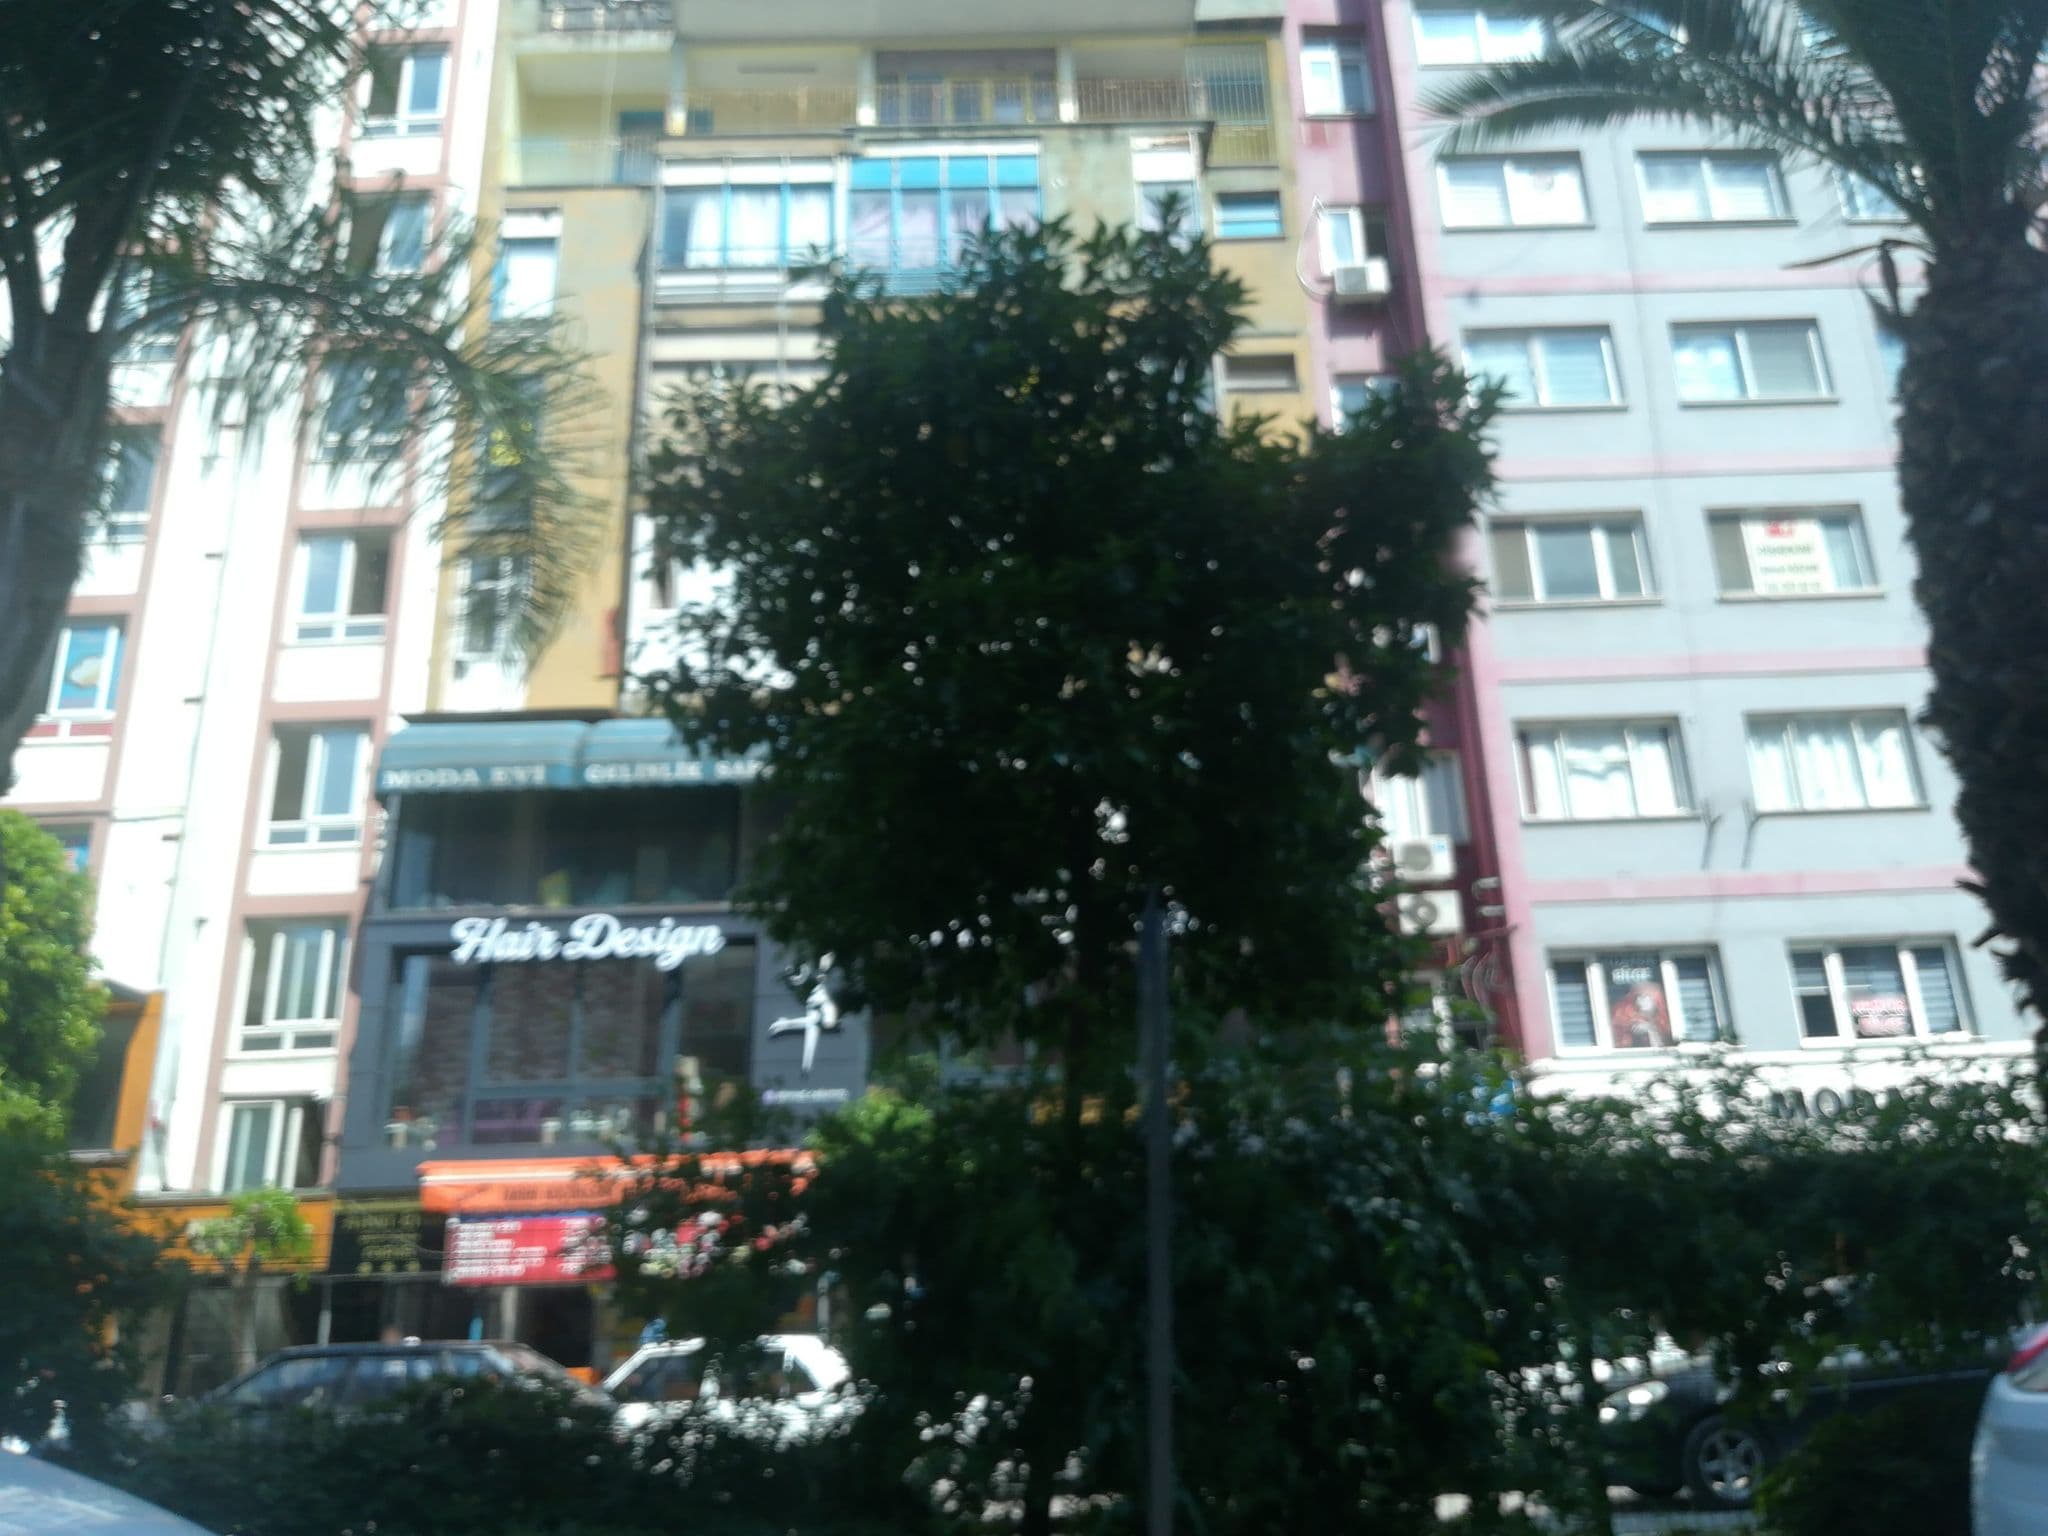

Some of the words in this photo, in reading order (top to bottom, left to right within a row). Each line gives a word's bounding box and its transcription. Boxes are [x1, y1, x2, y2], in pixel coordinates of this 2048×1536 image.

[382, 768, 481, 789] MODA
[450, 917, 562, 964] Hair
[561, 913, 726, 971] Design
